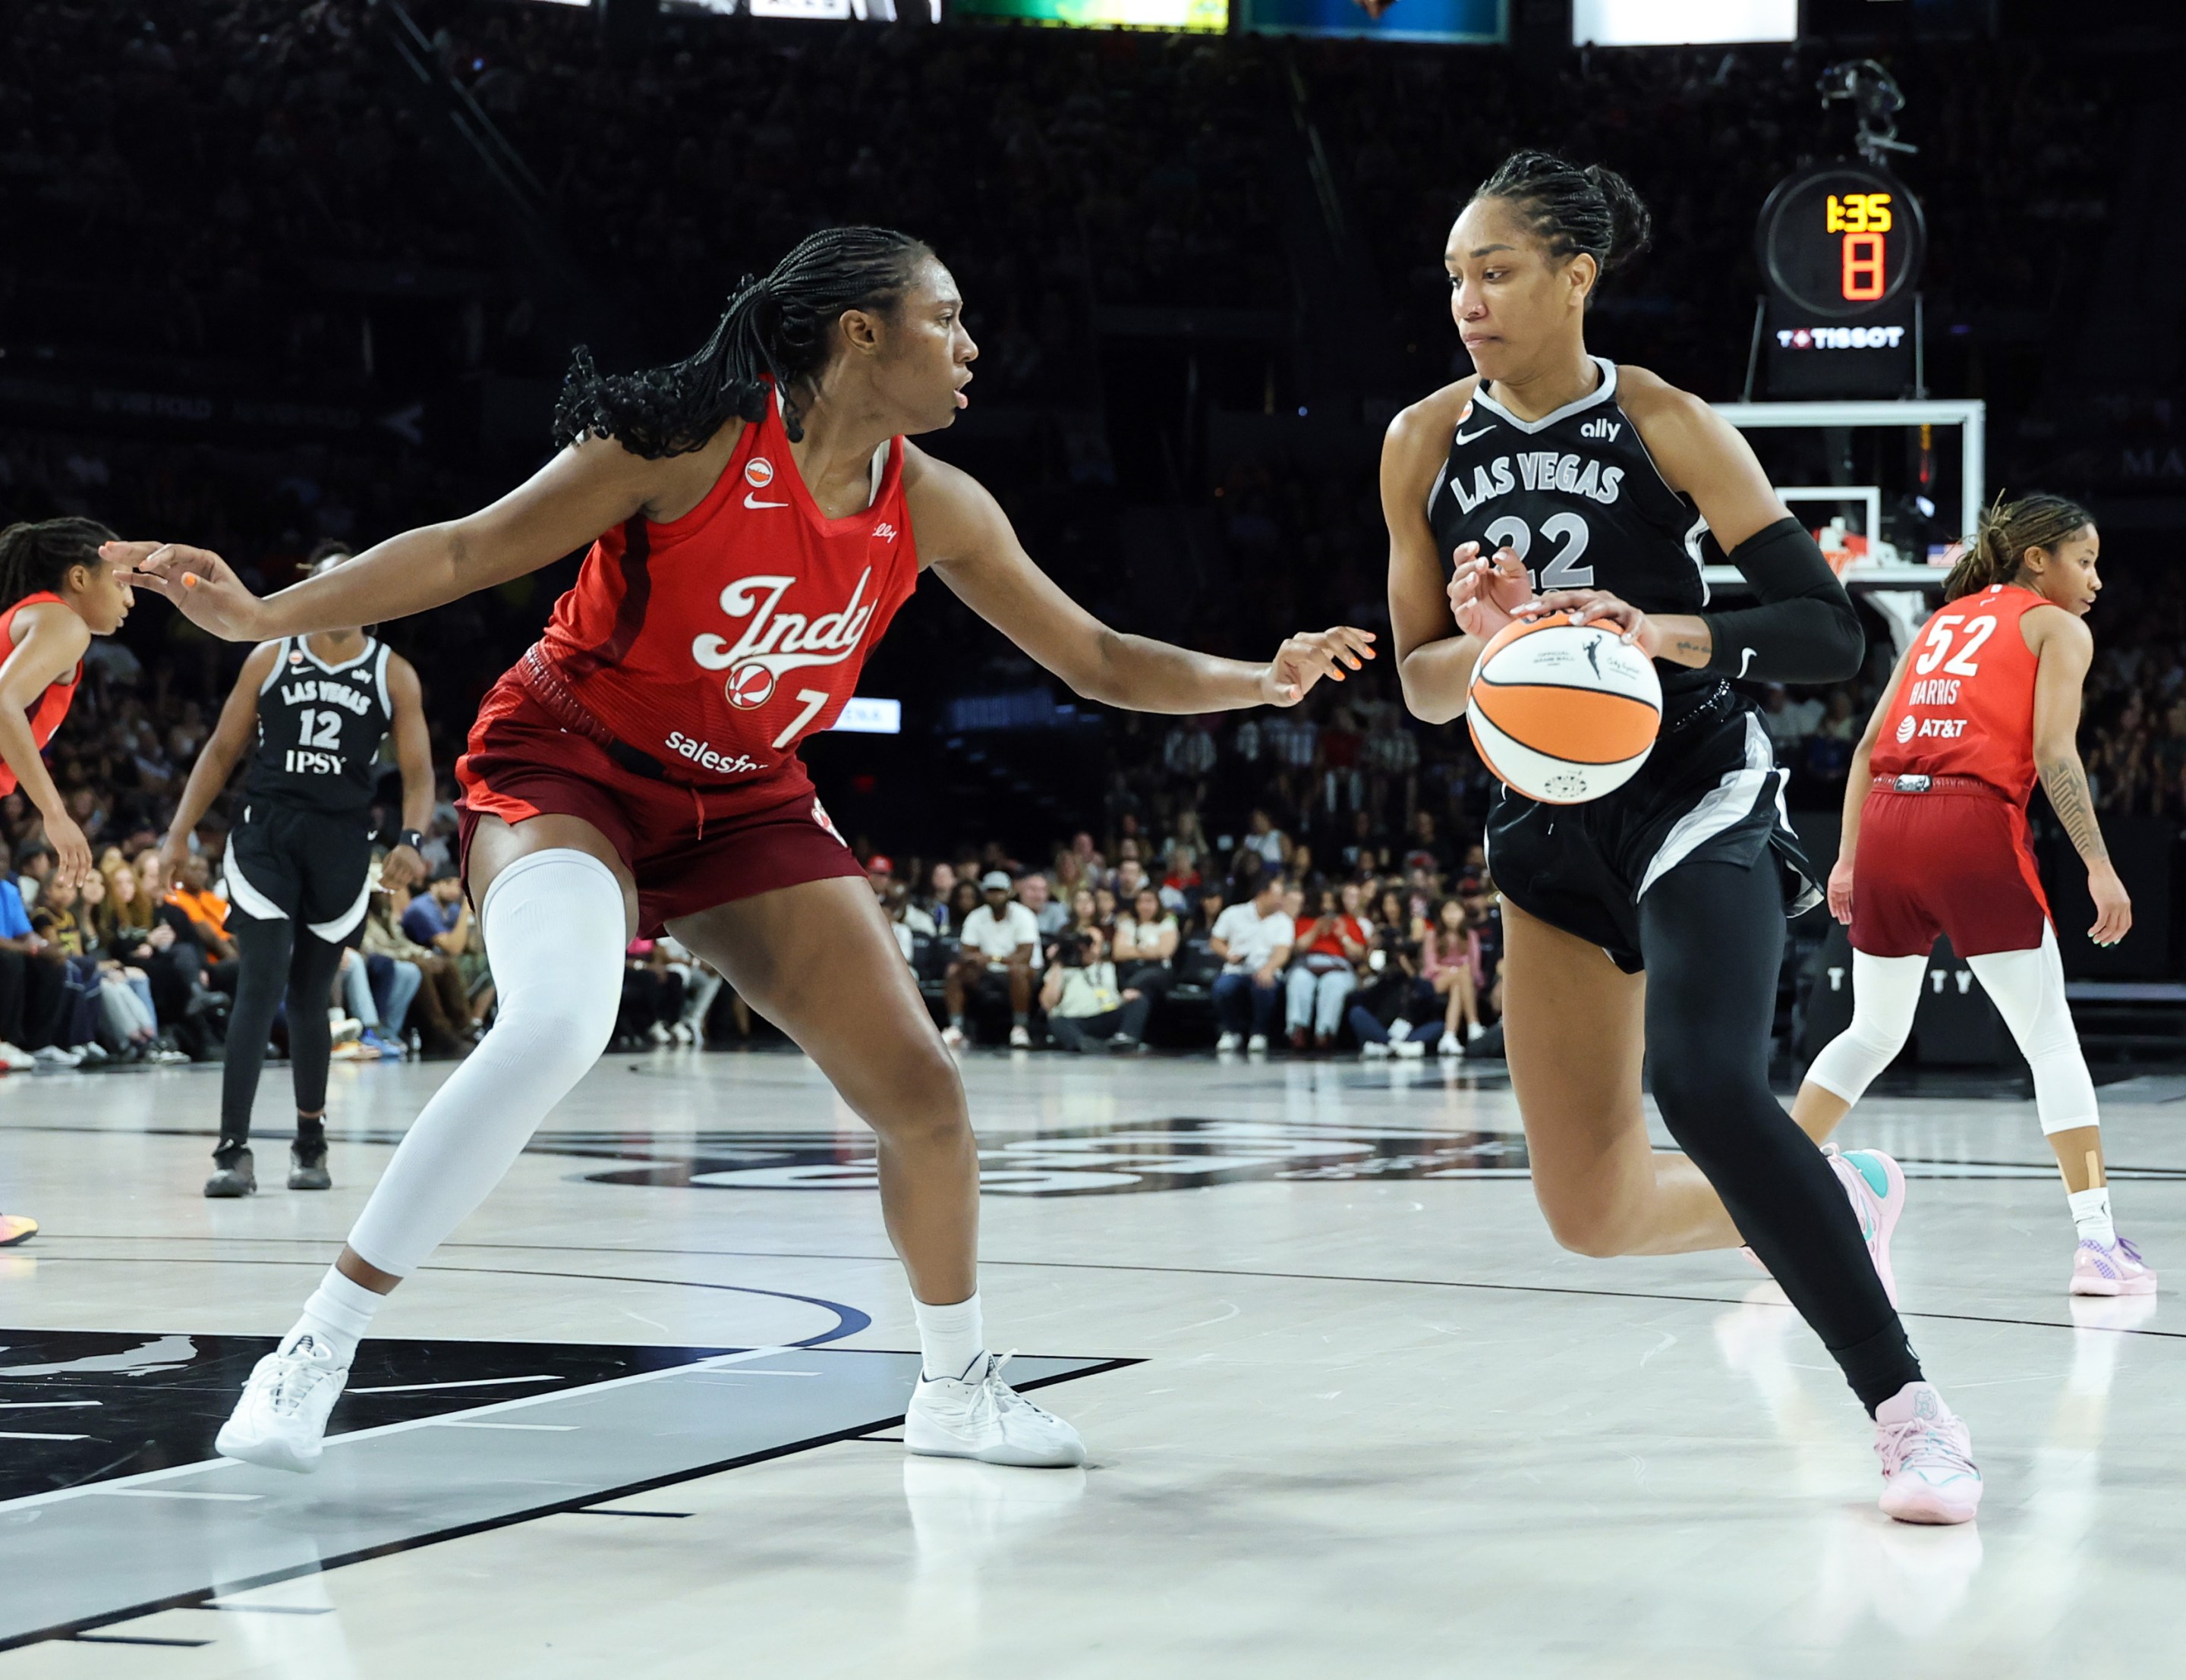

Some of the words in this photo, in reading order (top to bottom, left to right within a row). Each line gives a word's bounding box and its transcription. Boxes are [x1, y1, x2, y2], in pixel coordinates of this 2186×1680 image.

[1827, 193, 1891, 233] 1:35
[1842, 232, 1885, 300] 8
[1810, 326, 1904, 349] TISSOT
[1580, 418, 1621, 442] ally
[1450, 456, 1516, 514] LAS
[1517, 452, 1625, 504] VEGAS
[691, 565, 879, 680] Indy
[1915, 615, 1997, 677] 52
[281, 681, 317, 706] LAS
[319, 681, 372, 716] VEGAS
[1909, 679, 1961, 706] HARRIS
[298, 708, 343, 750] 12
[772, 688, 830, 748] 7
[1918, 719, 1967, 738] AT&T
[285, 750, 347, 775] IPSY
